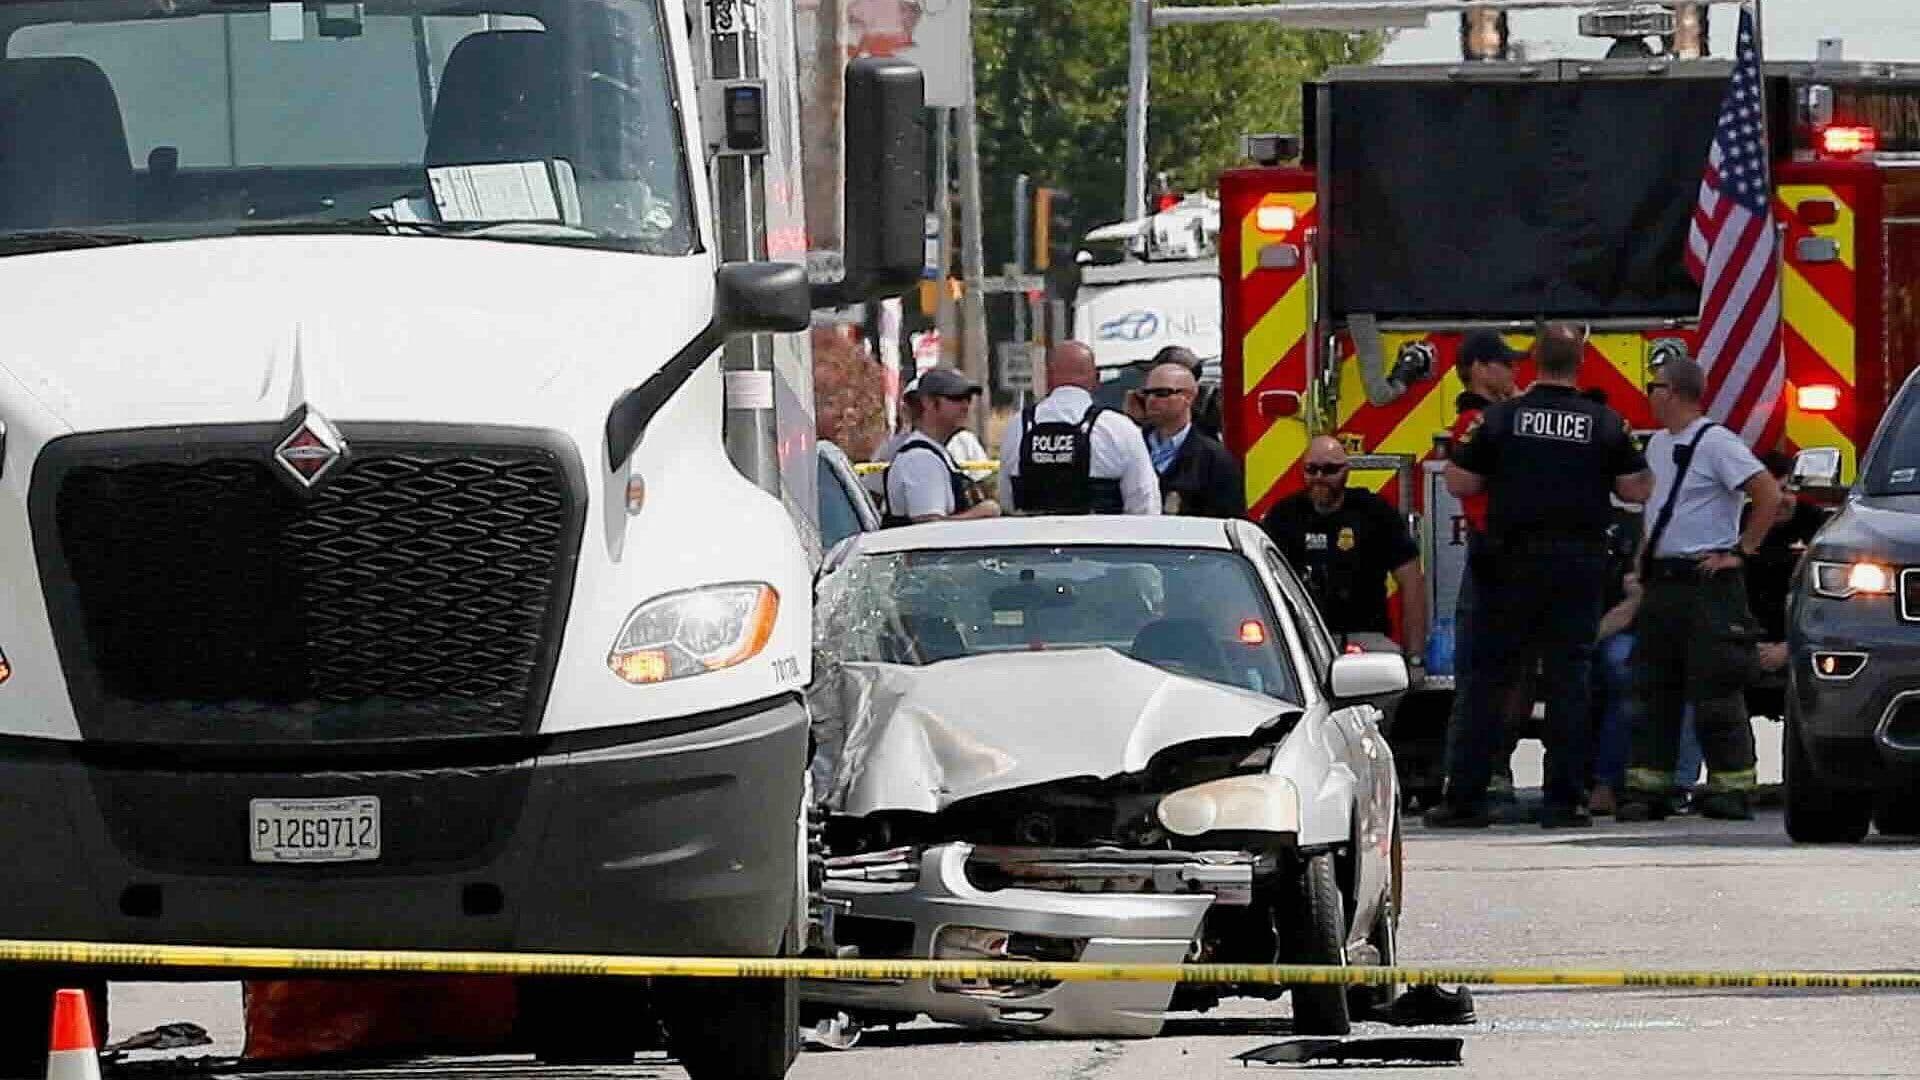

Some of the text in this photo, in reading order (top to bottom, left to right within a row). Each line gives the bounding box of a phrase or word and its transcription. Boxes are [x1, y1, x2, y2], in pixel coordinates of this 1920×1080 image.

[1521, 412, 1585, 438] POLICE
[1031, 433, 1074, 452] POLICE
[257, 816, 372, 850] P1269712
